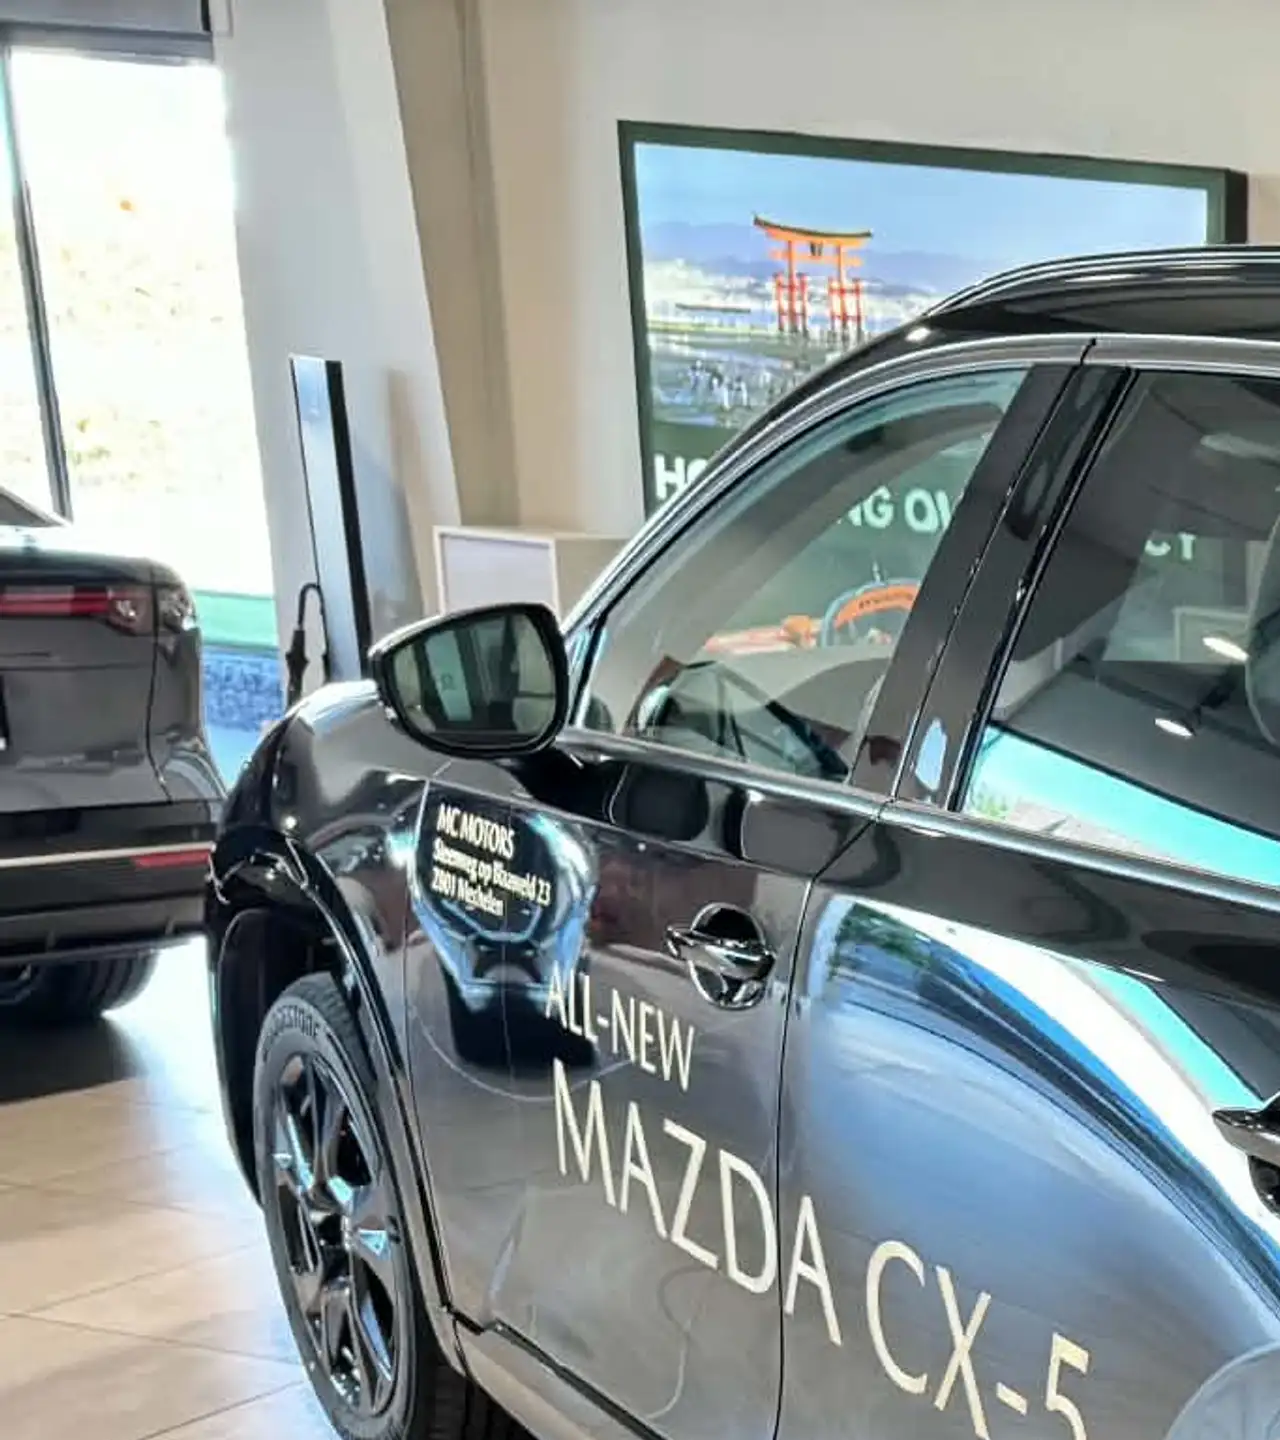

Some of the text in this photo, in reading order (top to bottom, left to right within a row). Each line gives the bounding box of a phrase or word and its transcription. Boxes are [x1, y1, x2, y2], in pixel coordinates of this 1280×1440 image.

[436, 803, 515, 860] MC MOTORS
[545, 960, 695, 1092] ALL-NEW
[553, 1056, 842, 1347] MAZDA
